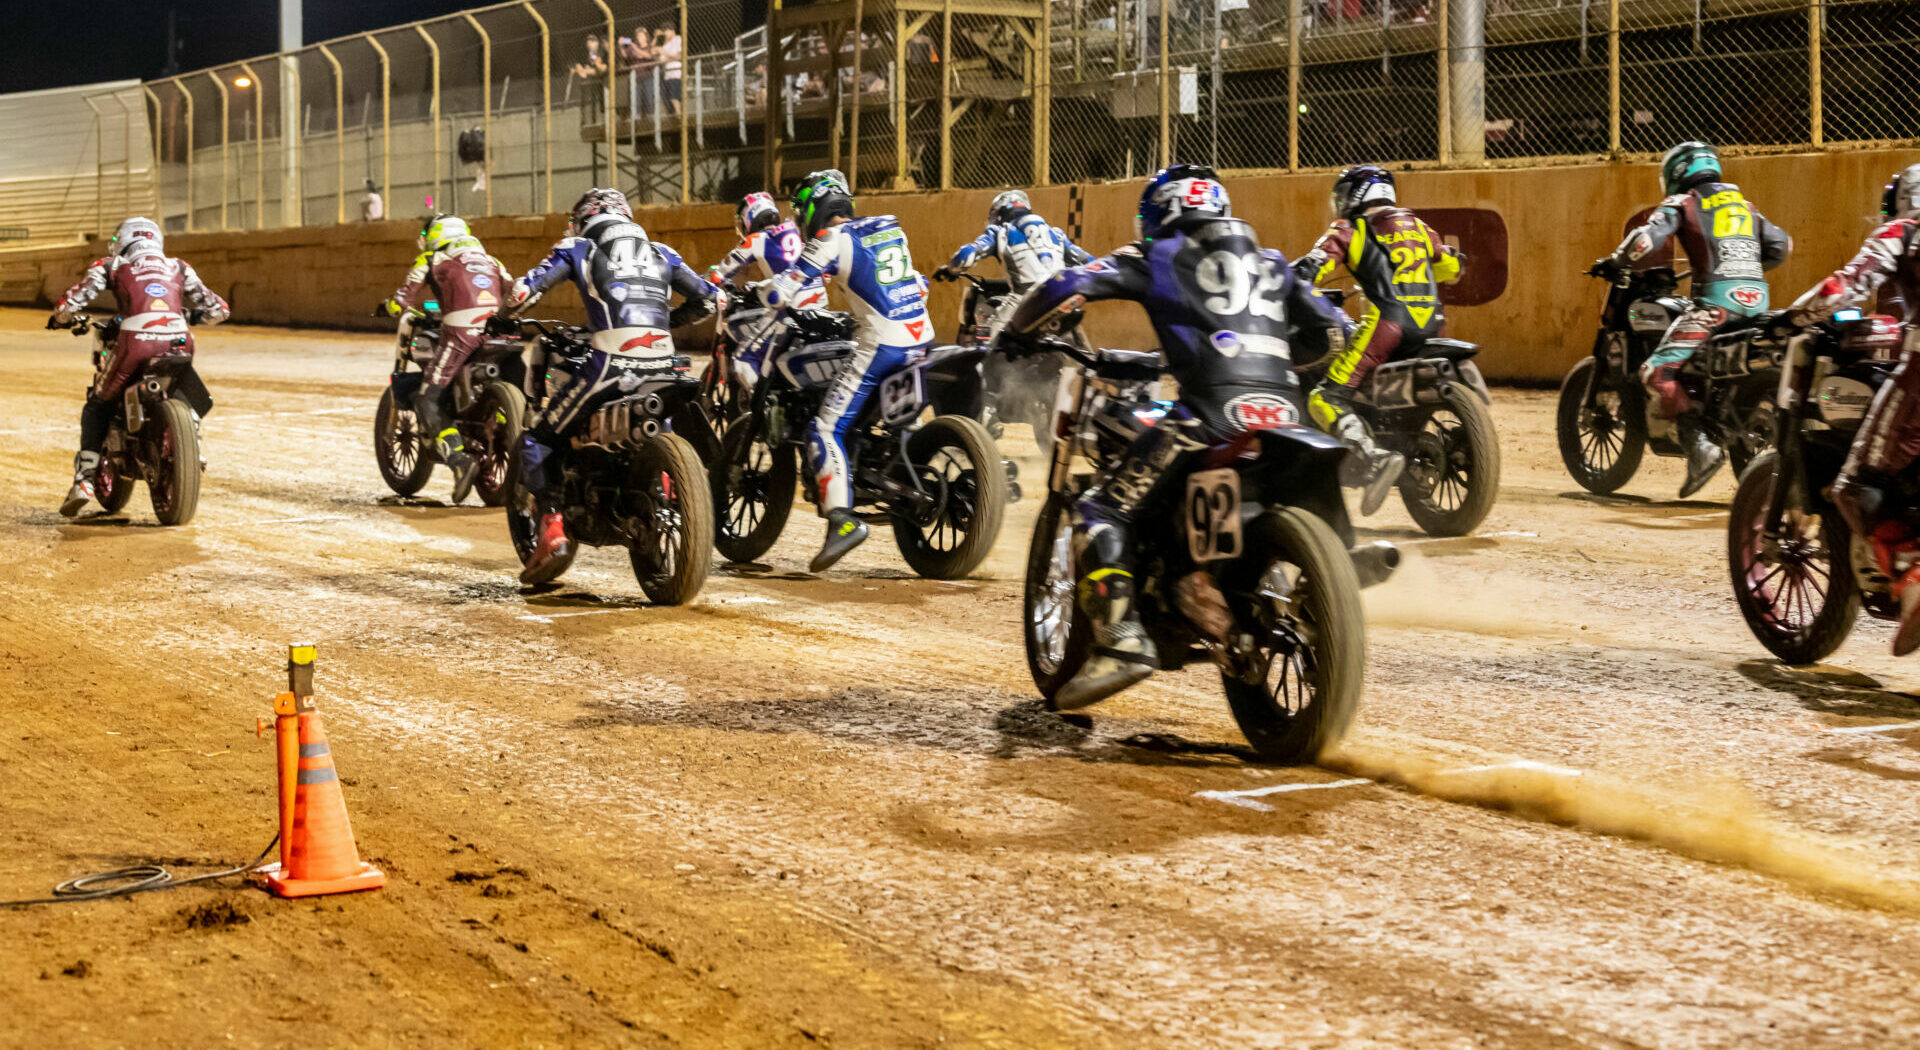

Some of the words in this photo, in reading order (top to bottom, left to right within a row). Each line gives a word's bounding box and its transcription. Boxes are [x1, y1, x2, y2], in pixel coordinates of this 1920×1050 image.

[1713, 206, 1753, 237] 67
[607, 237, 661, 279] 44
[1195, 250, 1285, 321] 92
[1192, 483, 1236, 552] 92
